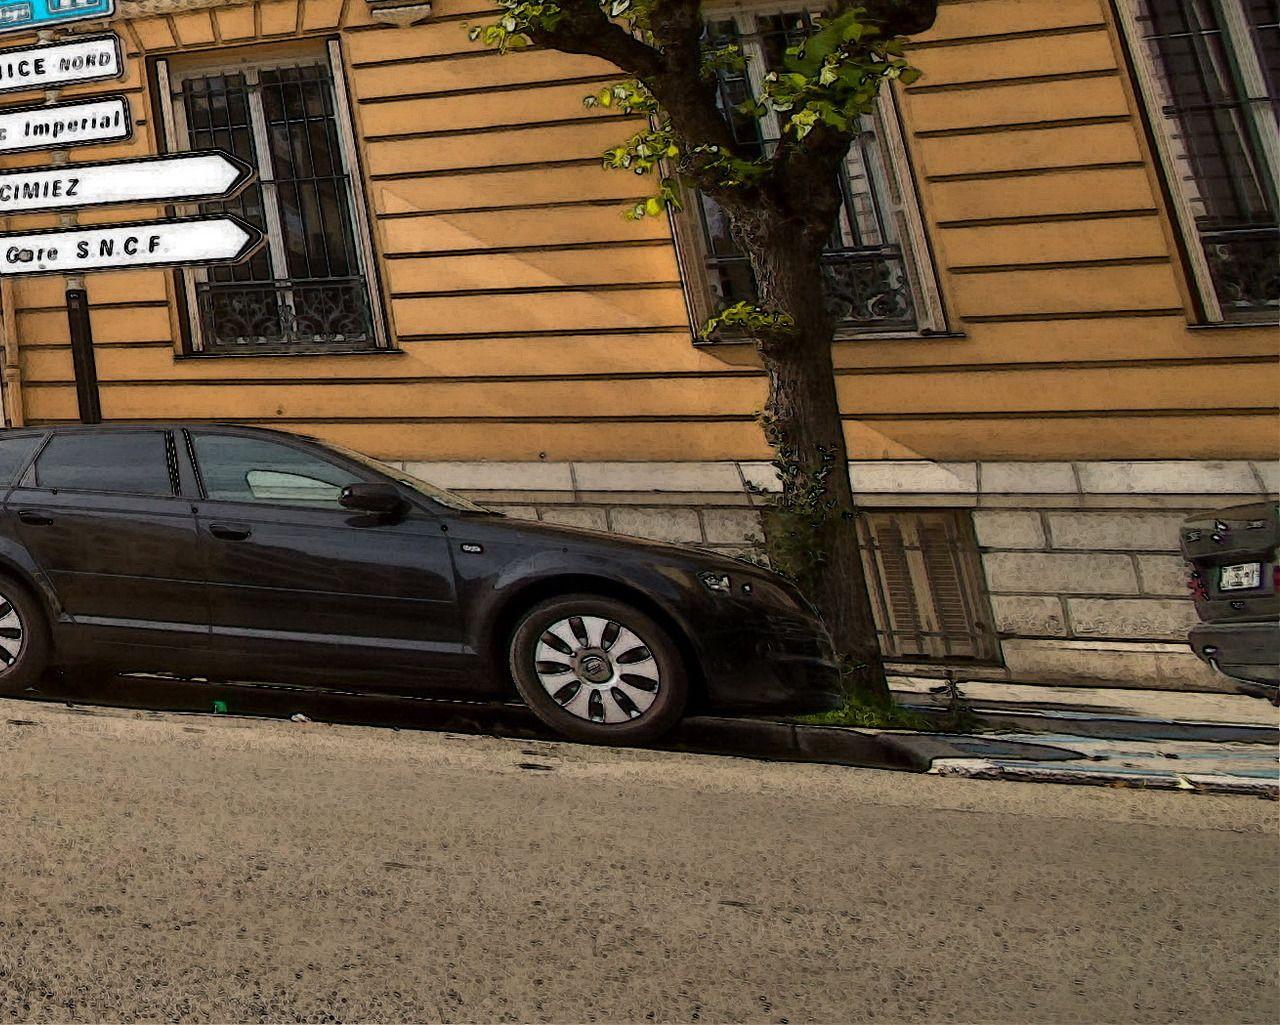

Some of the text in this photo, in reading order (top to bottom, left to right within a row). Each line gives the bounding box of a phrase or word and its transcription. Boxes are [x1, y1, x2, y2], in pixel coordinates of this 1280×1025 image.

[59, 51, 111, 71] NORD
[24, 110, 120, 138] Imperial
[6, 246, 59, 264] Gre
